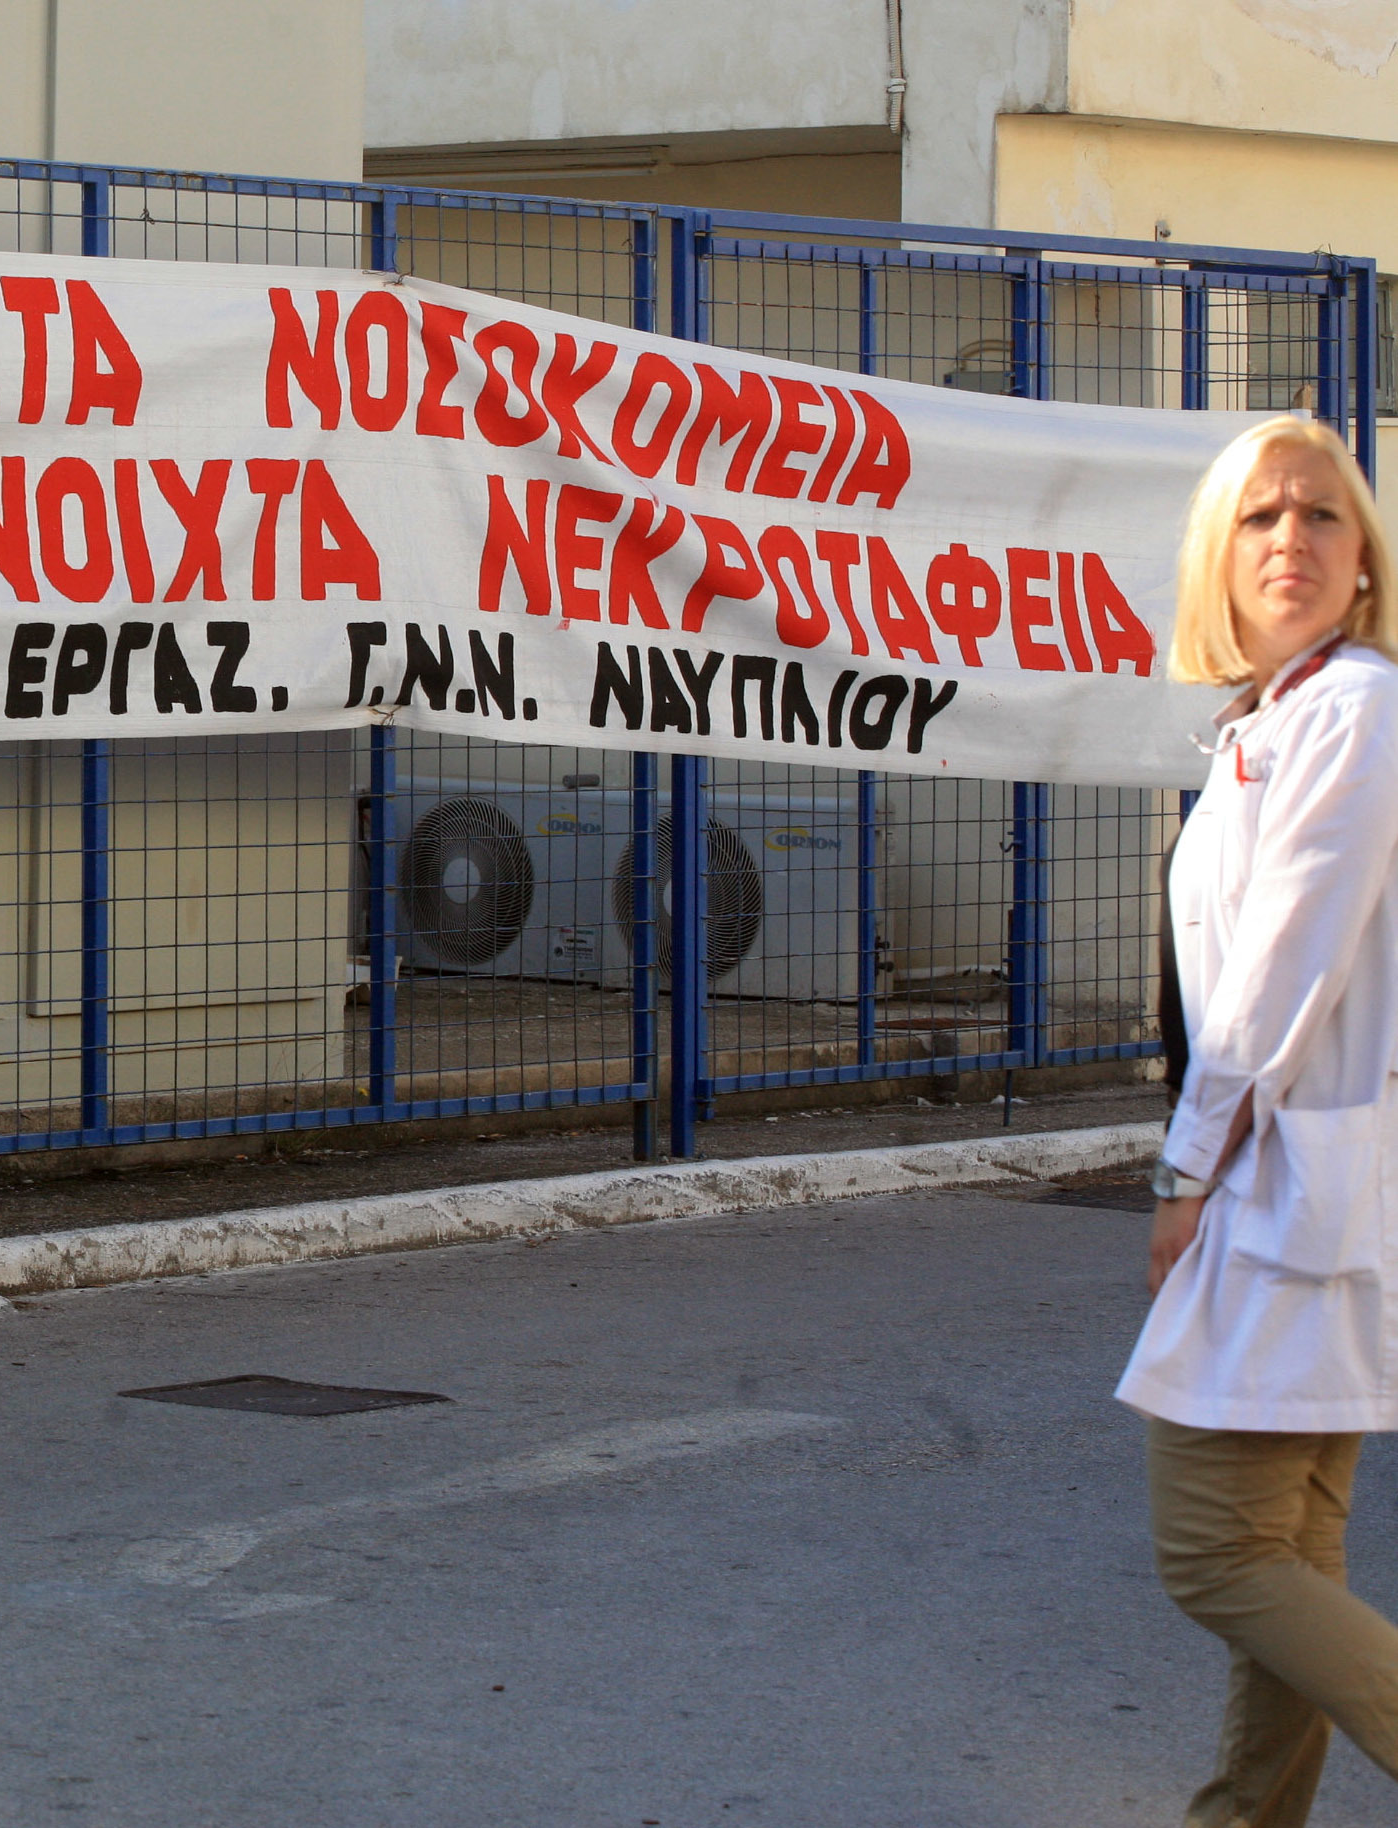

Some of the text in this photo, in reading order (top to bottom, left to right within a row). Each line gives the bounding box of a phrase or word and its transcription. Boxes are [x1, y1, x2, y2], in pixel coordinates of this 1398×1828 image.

[265, 287, 912, 511] ΝΟΣΟΚΟΜΕΙΑ
[478, 474, 1157, 678] ΝΕΚΡΟΤΑΦΕΙΑ
[4, 621, 289, 720] ΕΡΓΑΖ.
[343, 621, 538, 721] Γ.Ν.Ν.
[589, 641, 959, 755] ΝΑΥΠΛΙΟΥ
